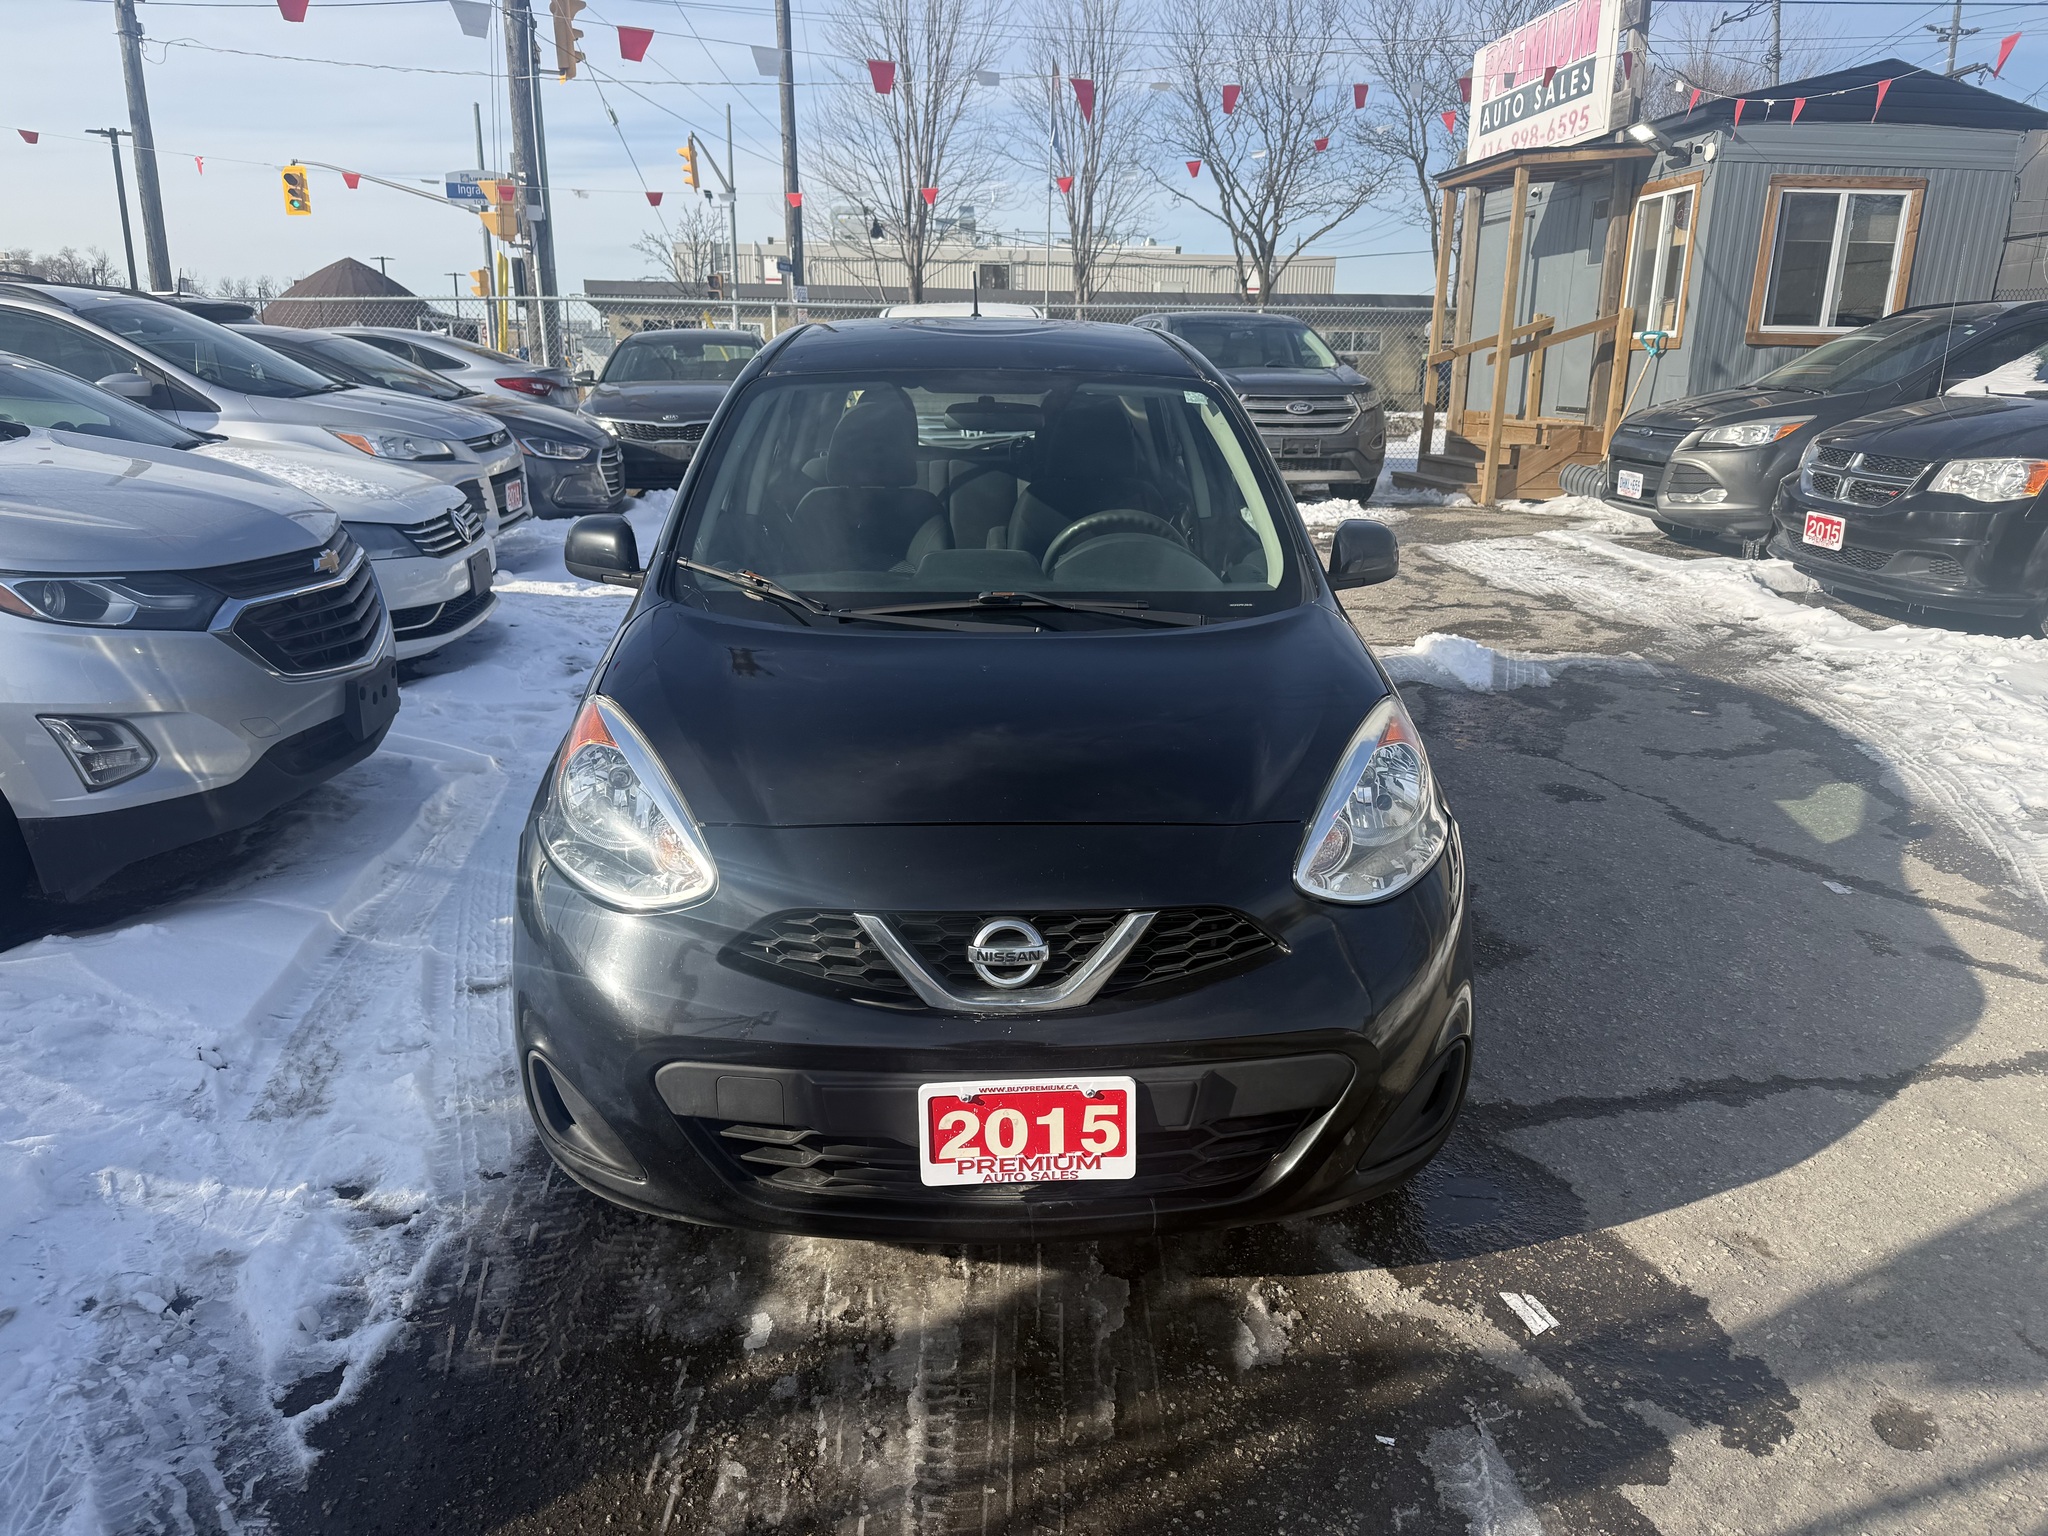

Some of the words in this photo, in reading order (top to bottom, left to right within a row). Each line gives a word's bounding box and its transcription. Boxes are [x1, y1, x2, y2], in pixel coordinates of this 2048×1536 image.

[1482, 0, 1600, 102] PREMIUM
[1482, 92, 1524, 131] AUTO
[1534, 65, 1591, 110] SALES
[457, 183, 485, 197] Ingra
[1807, 519, 1841, 542] 2015
[976, 949, 1041, 962] NISSAN
[979, 1083, 1079, 1093] WWW.BUYPREMIUM.CA
[938, 1104, 1121, 1160] 2015
[956, 1152, 1102, 1175] PREMIUM
[983, 1172, 1026, 1183] AUTO
[1031, 1170, 1079, 1181] SALES
